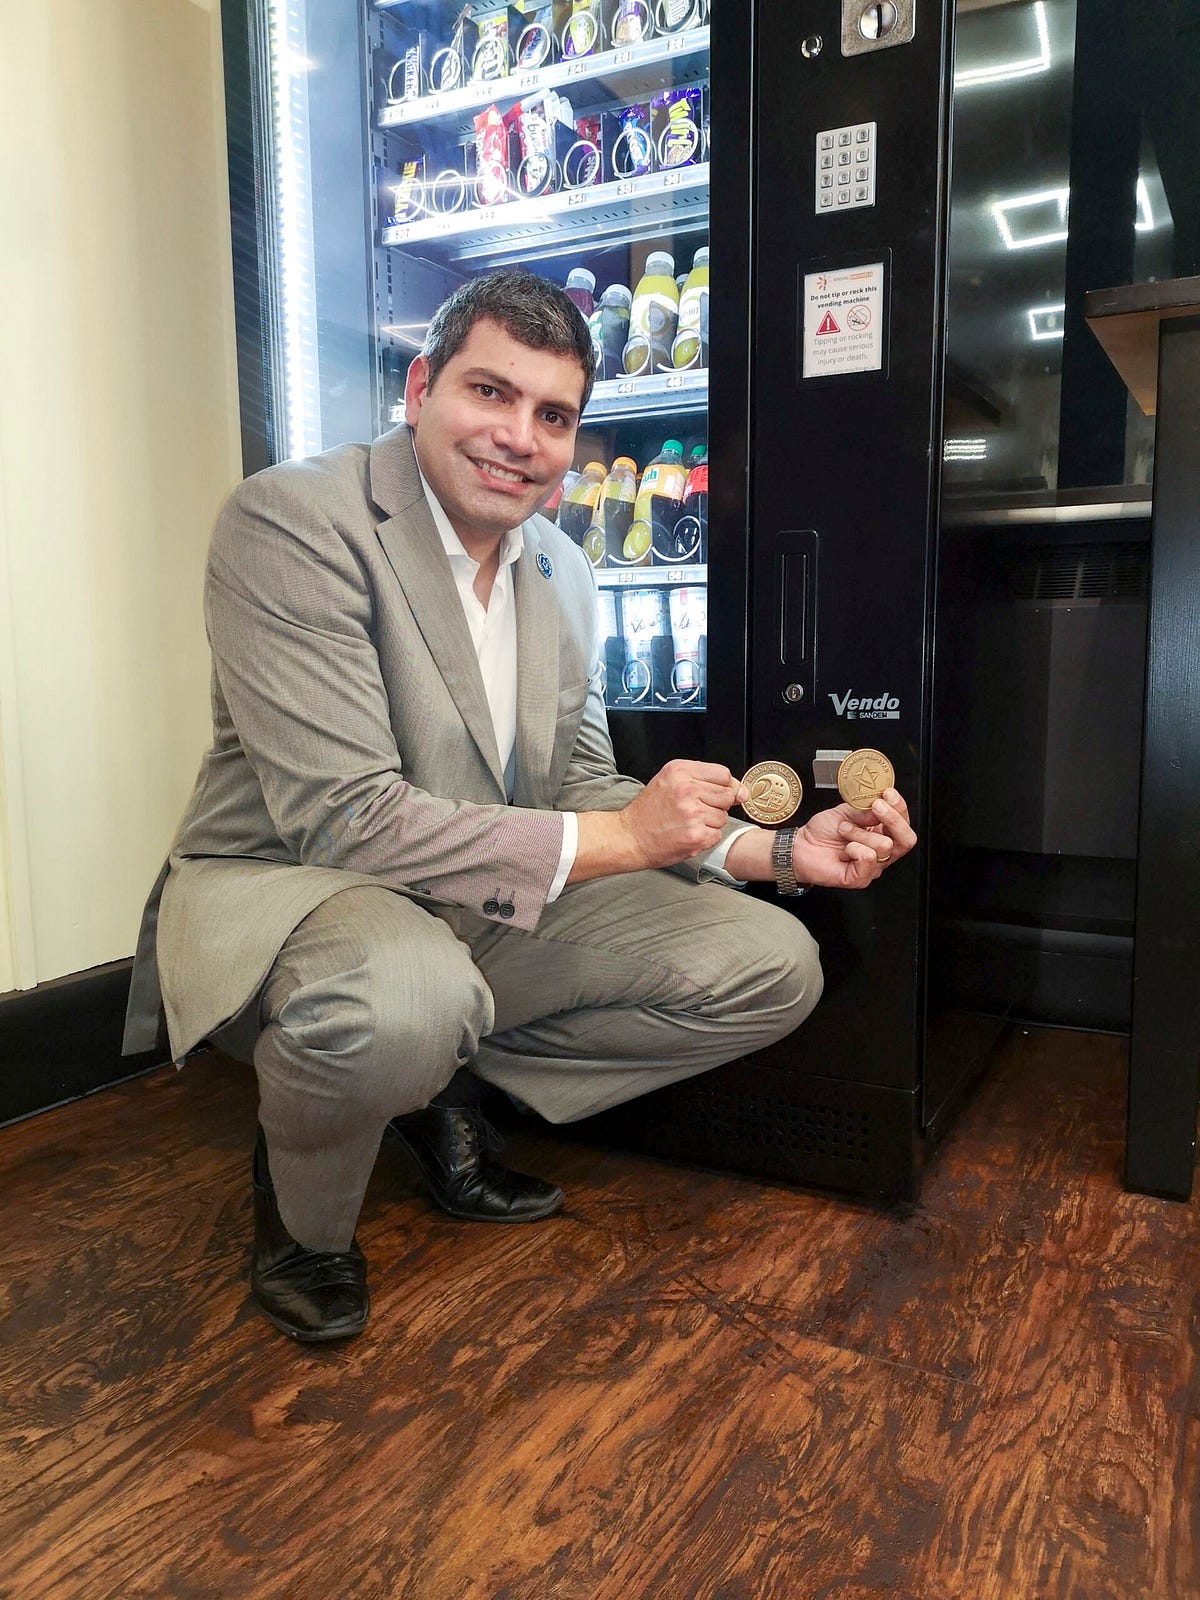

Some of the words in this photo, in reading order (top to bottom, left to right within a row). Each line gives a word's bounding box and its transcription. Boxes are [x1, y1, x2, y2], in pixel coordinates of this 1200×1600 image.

[850, 287, 863, 295] rock
[865, 285, 877, 293] this
[817, 300, 842, 308] vending
[843, 296, 870, 305] machine
[814, 337, 838, 346] Tipping
[848, 332, 873, 341] rocking
[828, 346, 848, 354] cause
[849, 342, 874, 351] serious
[817, 357, 837, 366] injury
[827, 688, 900, 716] Vendo
[751, 778, 773, 808] 2
